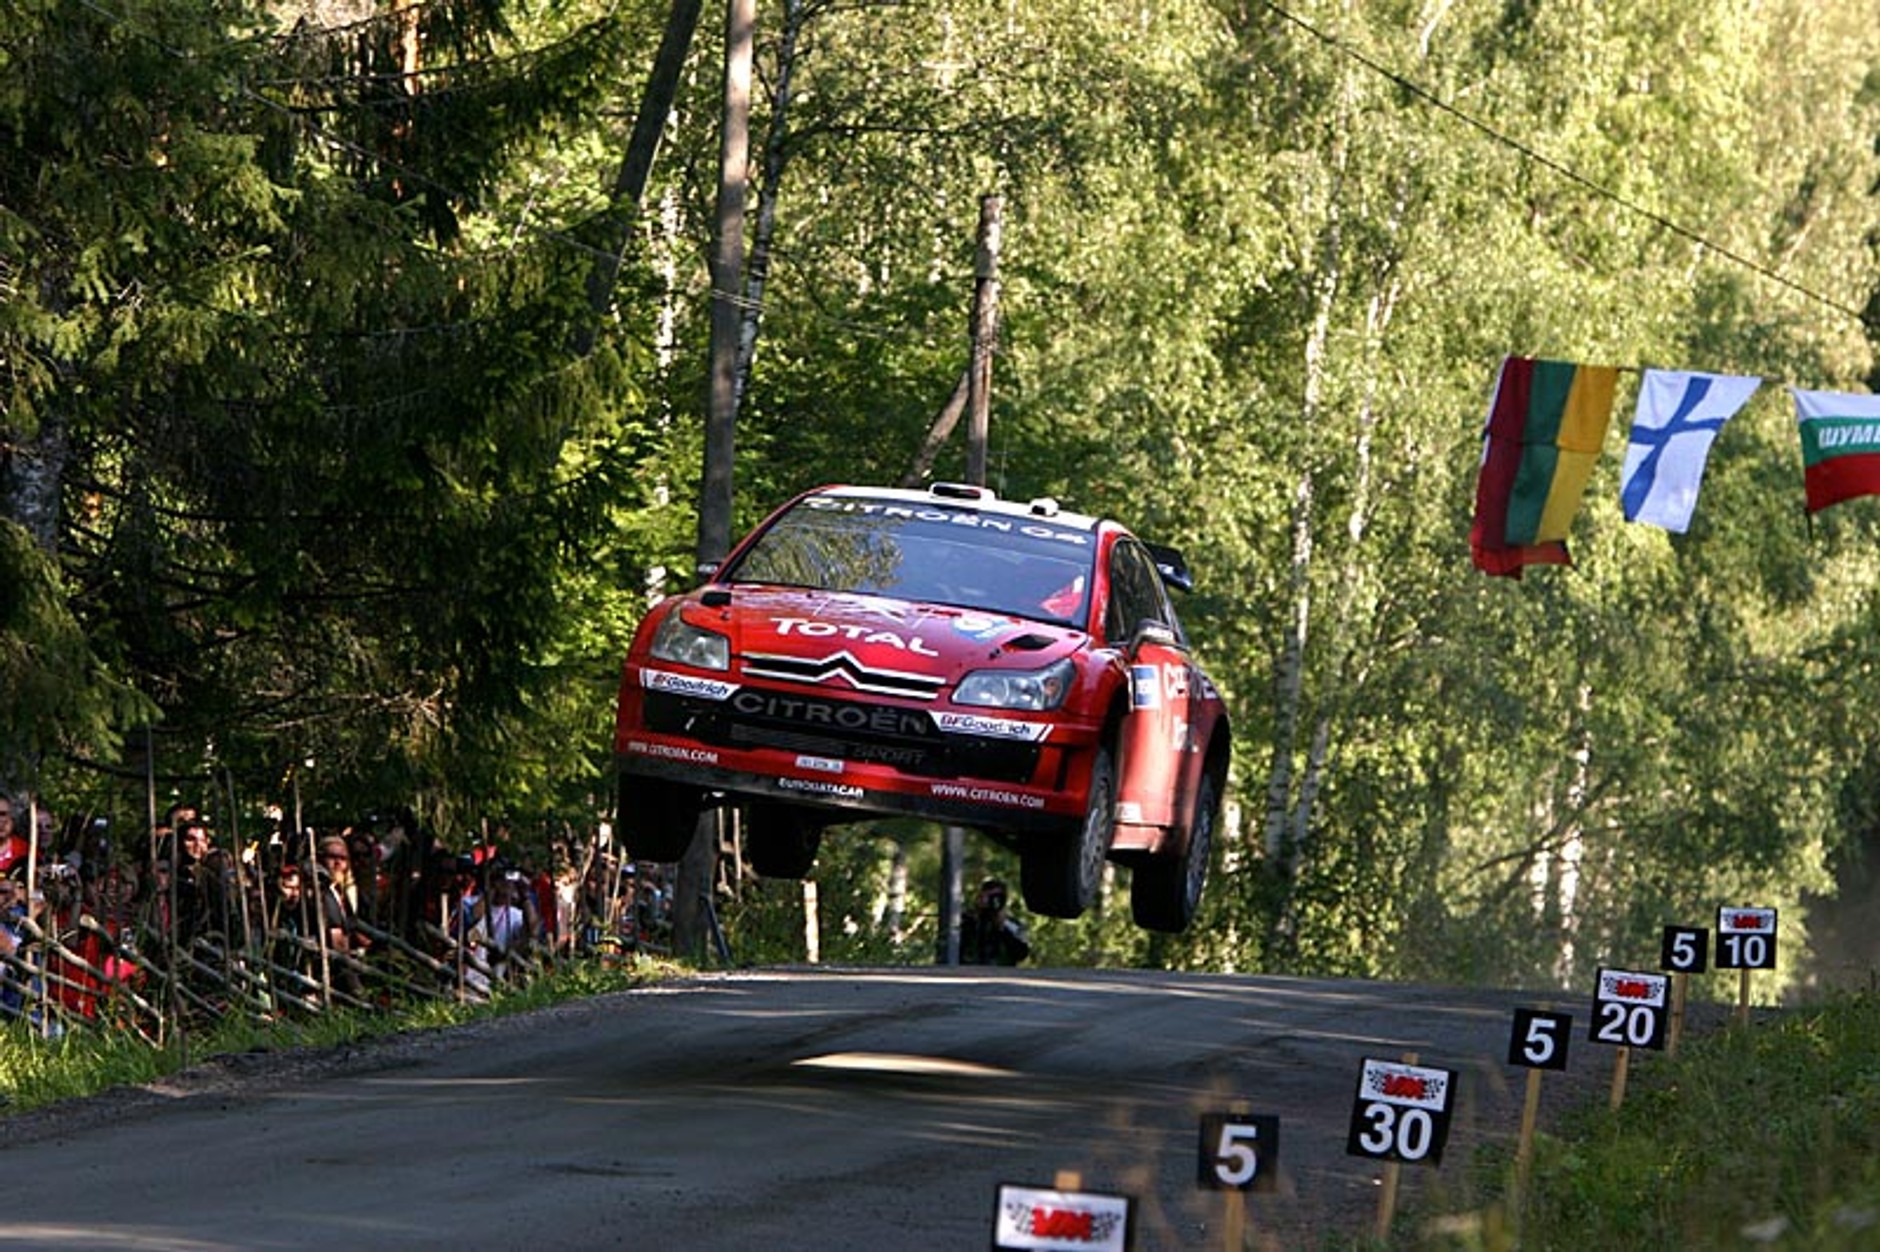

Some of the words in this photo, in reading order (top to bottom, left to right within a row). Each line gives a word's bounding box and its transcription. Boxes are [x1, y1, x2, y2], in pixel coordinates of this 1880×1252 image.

[1020, 524, 1088, 545] C4
[769, 616, 940, 657] TOTAL
[652, 672, 731, 698] BFGoodrich
[732, 692, 929, 735] CITROËN
[939, 713, 1032, 735] BFGoodrich
[1670, 932, 1696, 968] 5
[1724, 935, 1767, 967] 10
[1523, 1017, 1557, 1064] 5
[1597, 1002, 1656, 1046] 20
[1359, 1102, 1434, 1161] 30
[1214, 1123, 1258, 1186] 5
